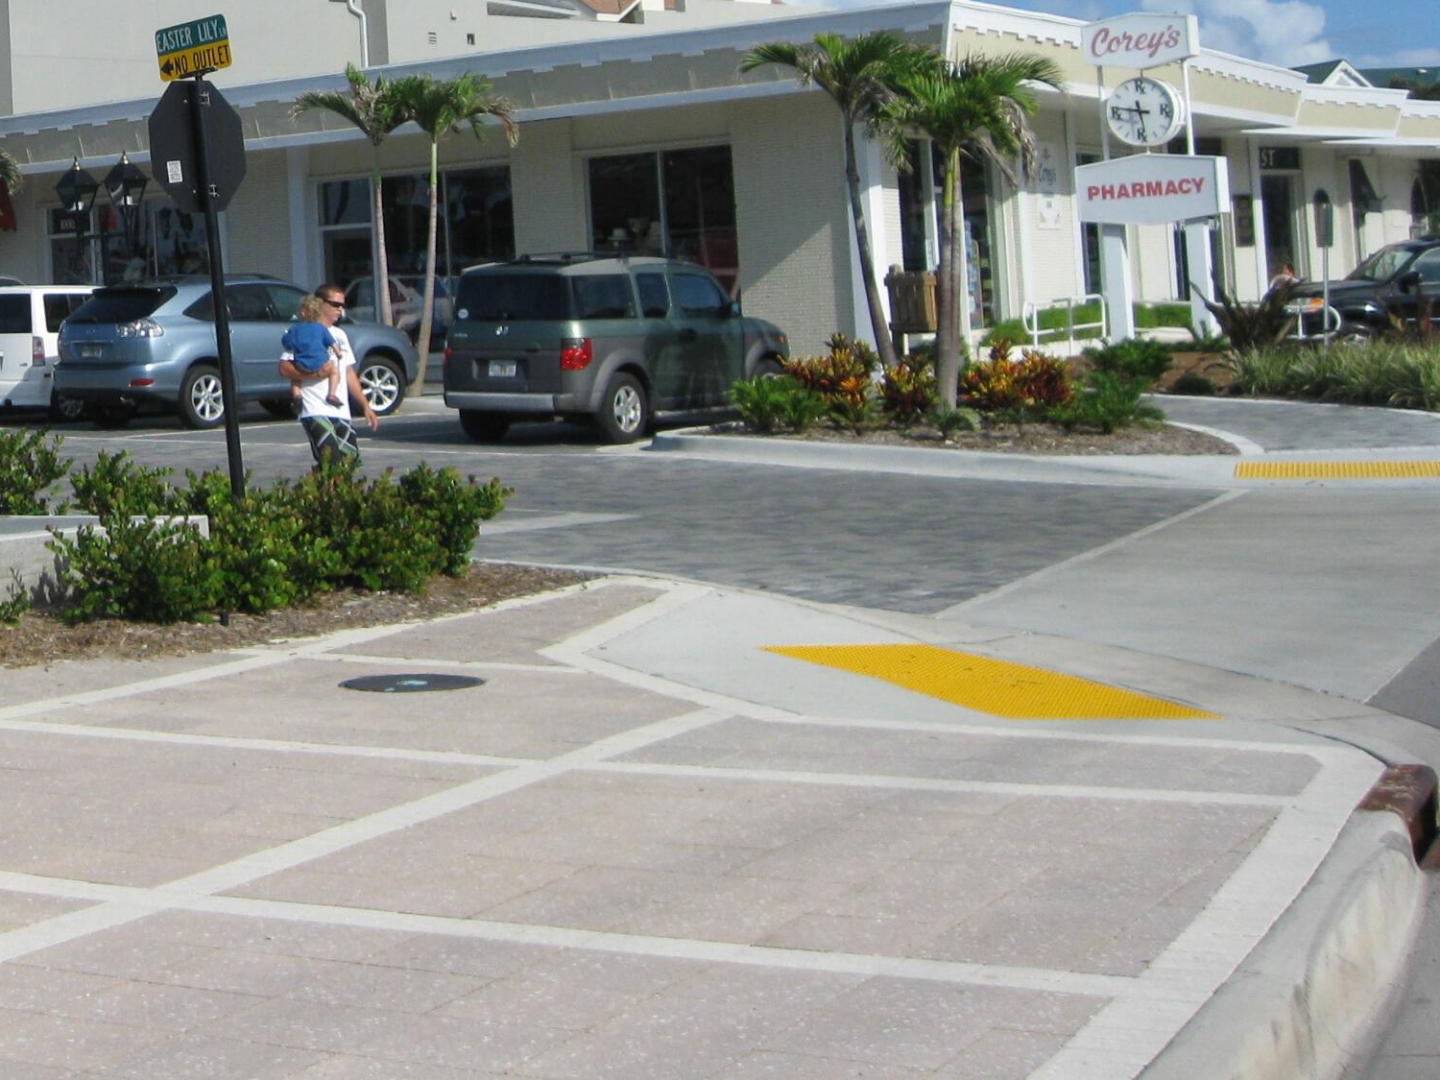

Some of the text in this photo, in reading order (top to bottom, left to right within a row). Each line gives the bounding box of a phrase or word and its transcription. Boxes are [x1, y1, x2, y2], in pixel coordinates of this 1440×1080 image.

[156, 26, 193, 52] EASTER
[197, 19, 218, 42] LILY
[1091, 25, 1181, 57] Corey's
[173, 45, 230, 75] NO OUTLET
[1087, 177, 1205, 201] PHARMACY
